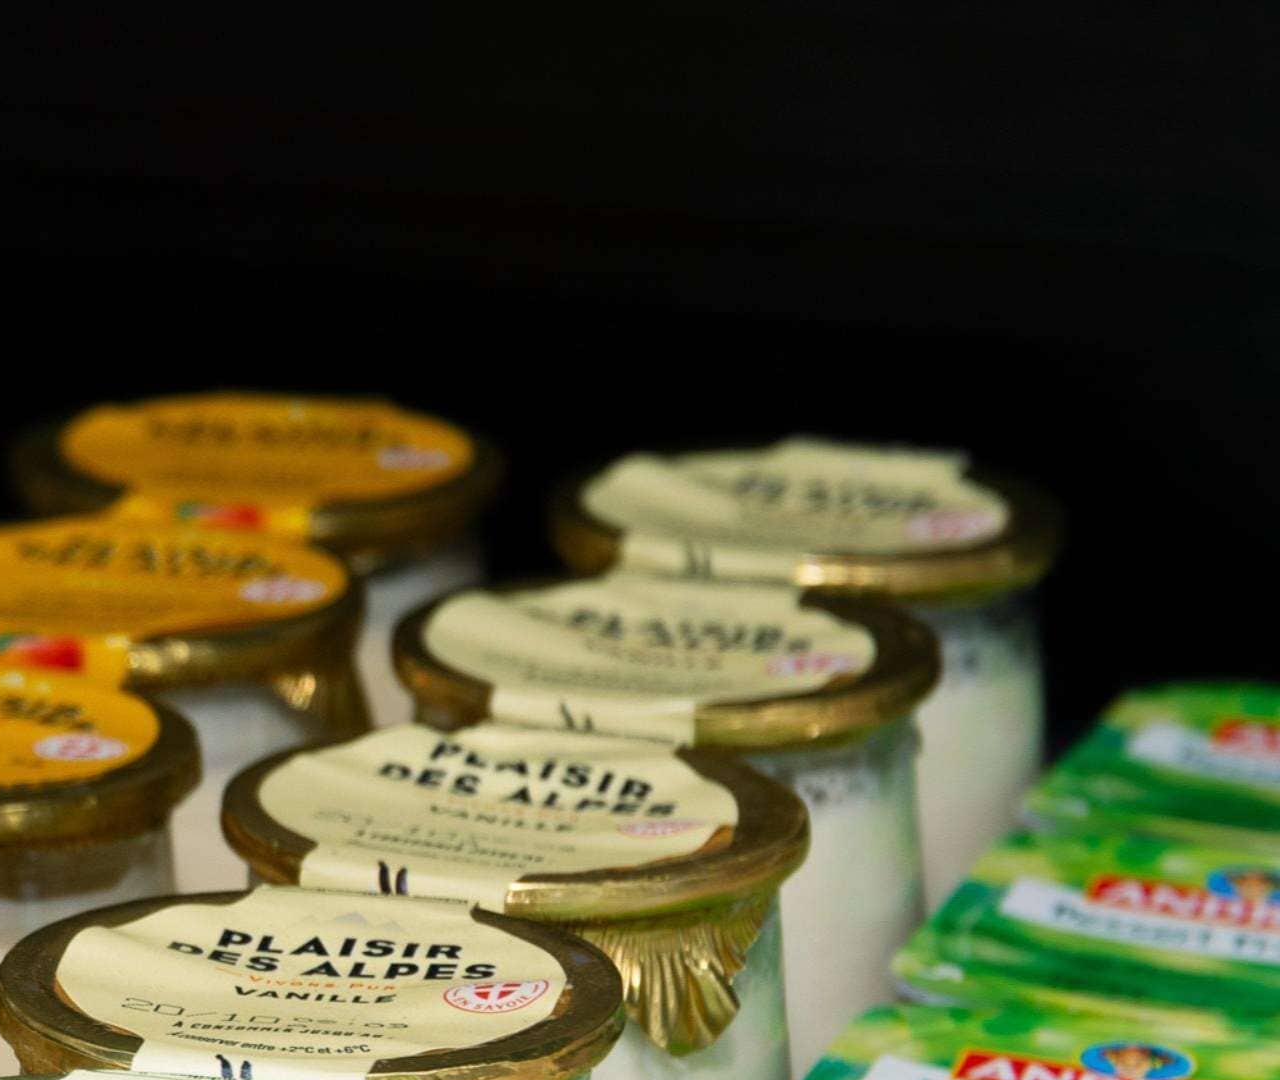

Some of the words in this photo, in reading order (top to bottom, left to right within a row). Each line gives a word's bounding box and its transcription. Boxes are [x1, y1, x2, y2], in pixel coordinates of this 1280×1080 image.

[431, 742, 653, 800] PLAISIR
[166, 940, 288, 972] DES
[300, 960, 498, 981] ALPES
[217, 929, 462, 960] PLAISIR
[233, 984, 398, 1005] VANILLE
